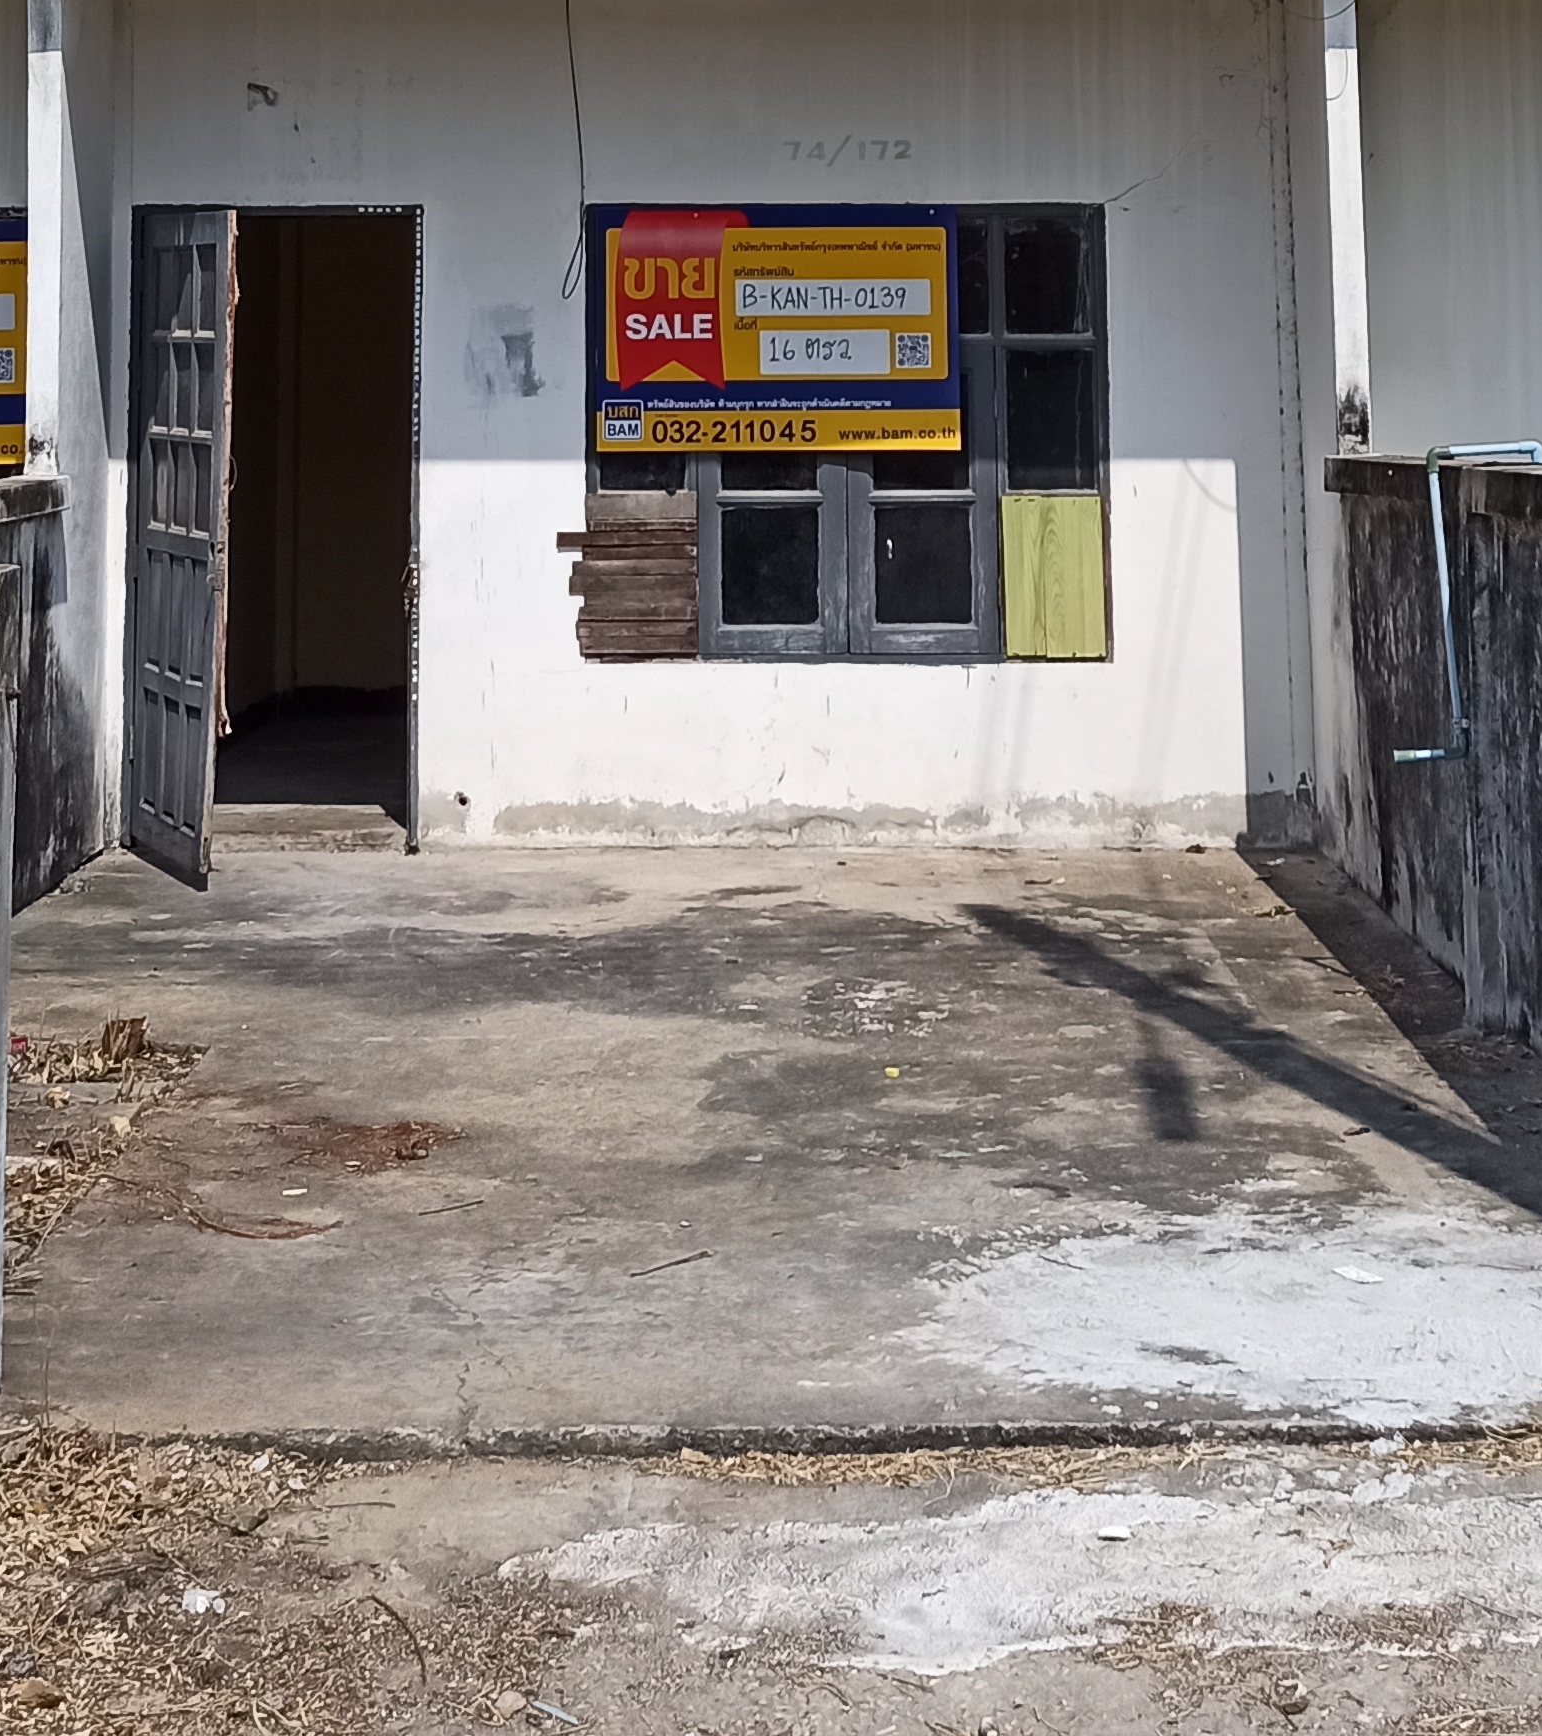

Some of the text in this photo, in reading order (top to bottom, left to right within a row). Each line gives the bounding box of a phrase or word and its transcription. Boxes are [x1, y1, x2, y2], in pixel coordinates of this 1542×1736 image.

[782, 134, 912, 168] 74/172
[624, 257, 715, 299] ขาย
[742, 284, 906, 310] B-KAN-TH-0139
[625, 313, 713, 339] SALE
[770, 337, 795, 362] 16
[607, 405, 639, 418] บสก
[608, 423, 639, 436] BAM
[652, 419, 817, 443] 032-211045
[838, 427, 956, 440] www.bam.co.th
